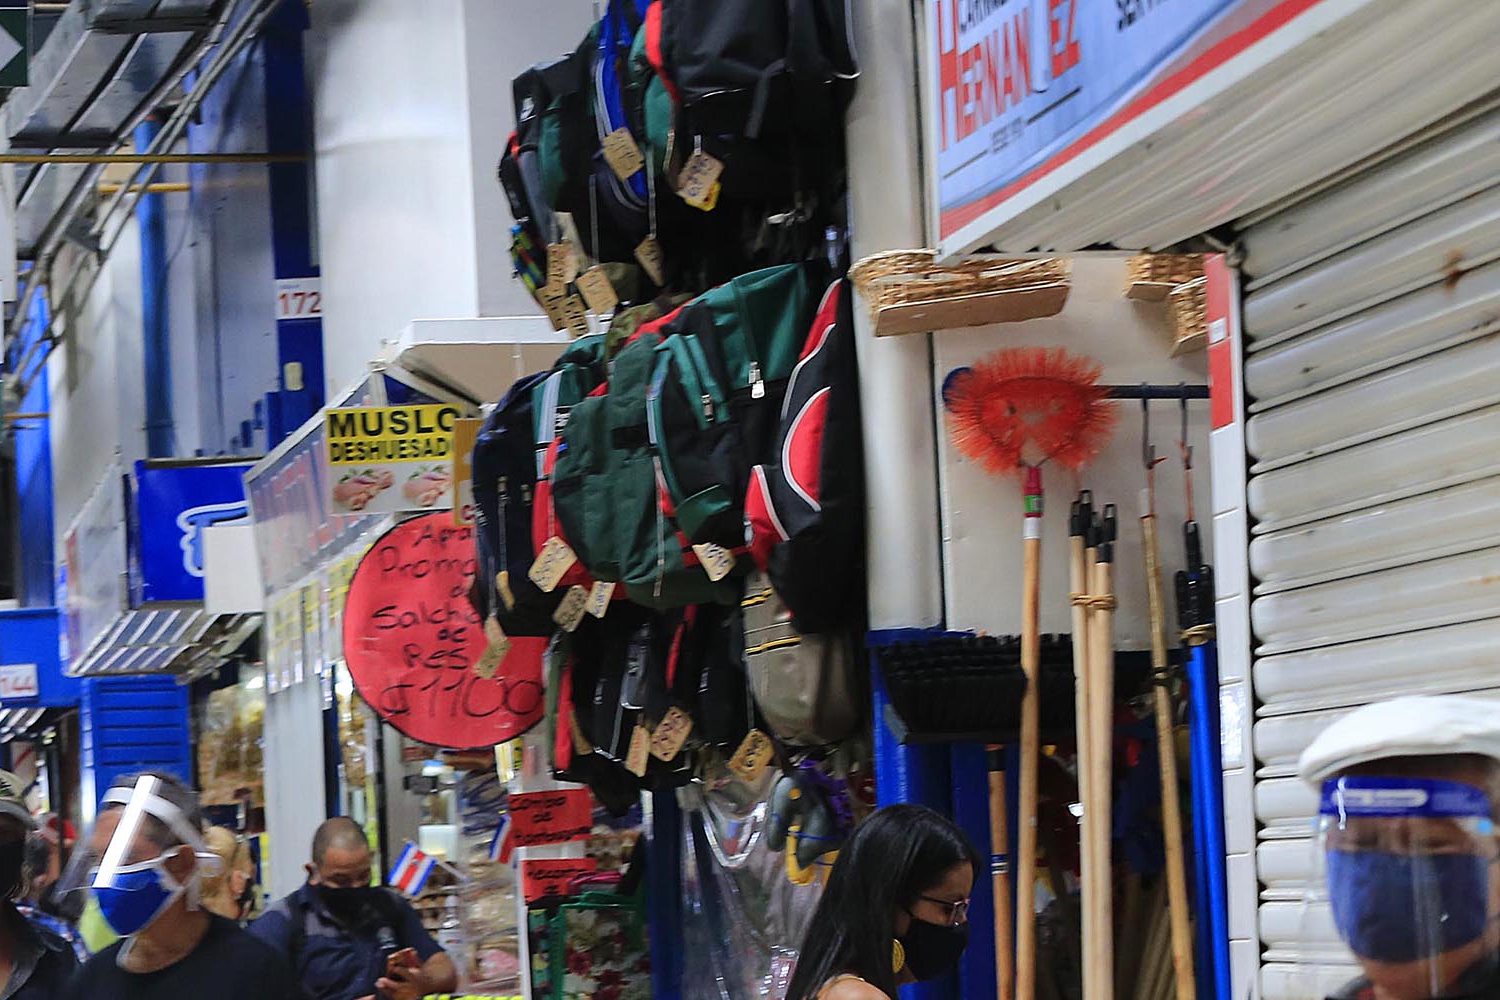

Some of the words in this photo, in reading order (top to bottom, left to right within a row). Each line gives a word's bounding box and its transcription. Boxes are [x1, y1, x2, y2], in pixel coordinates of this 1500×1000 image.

[936, 0, 1083, 152] HERNANEZ
[278, 291, 322, 315] 172
[330, 437, 451, 462] DESHUESAD
